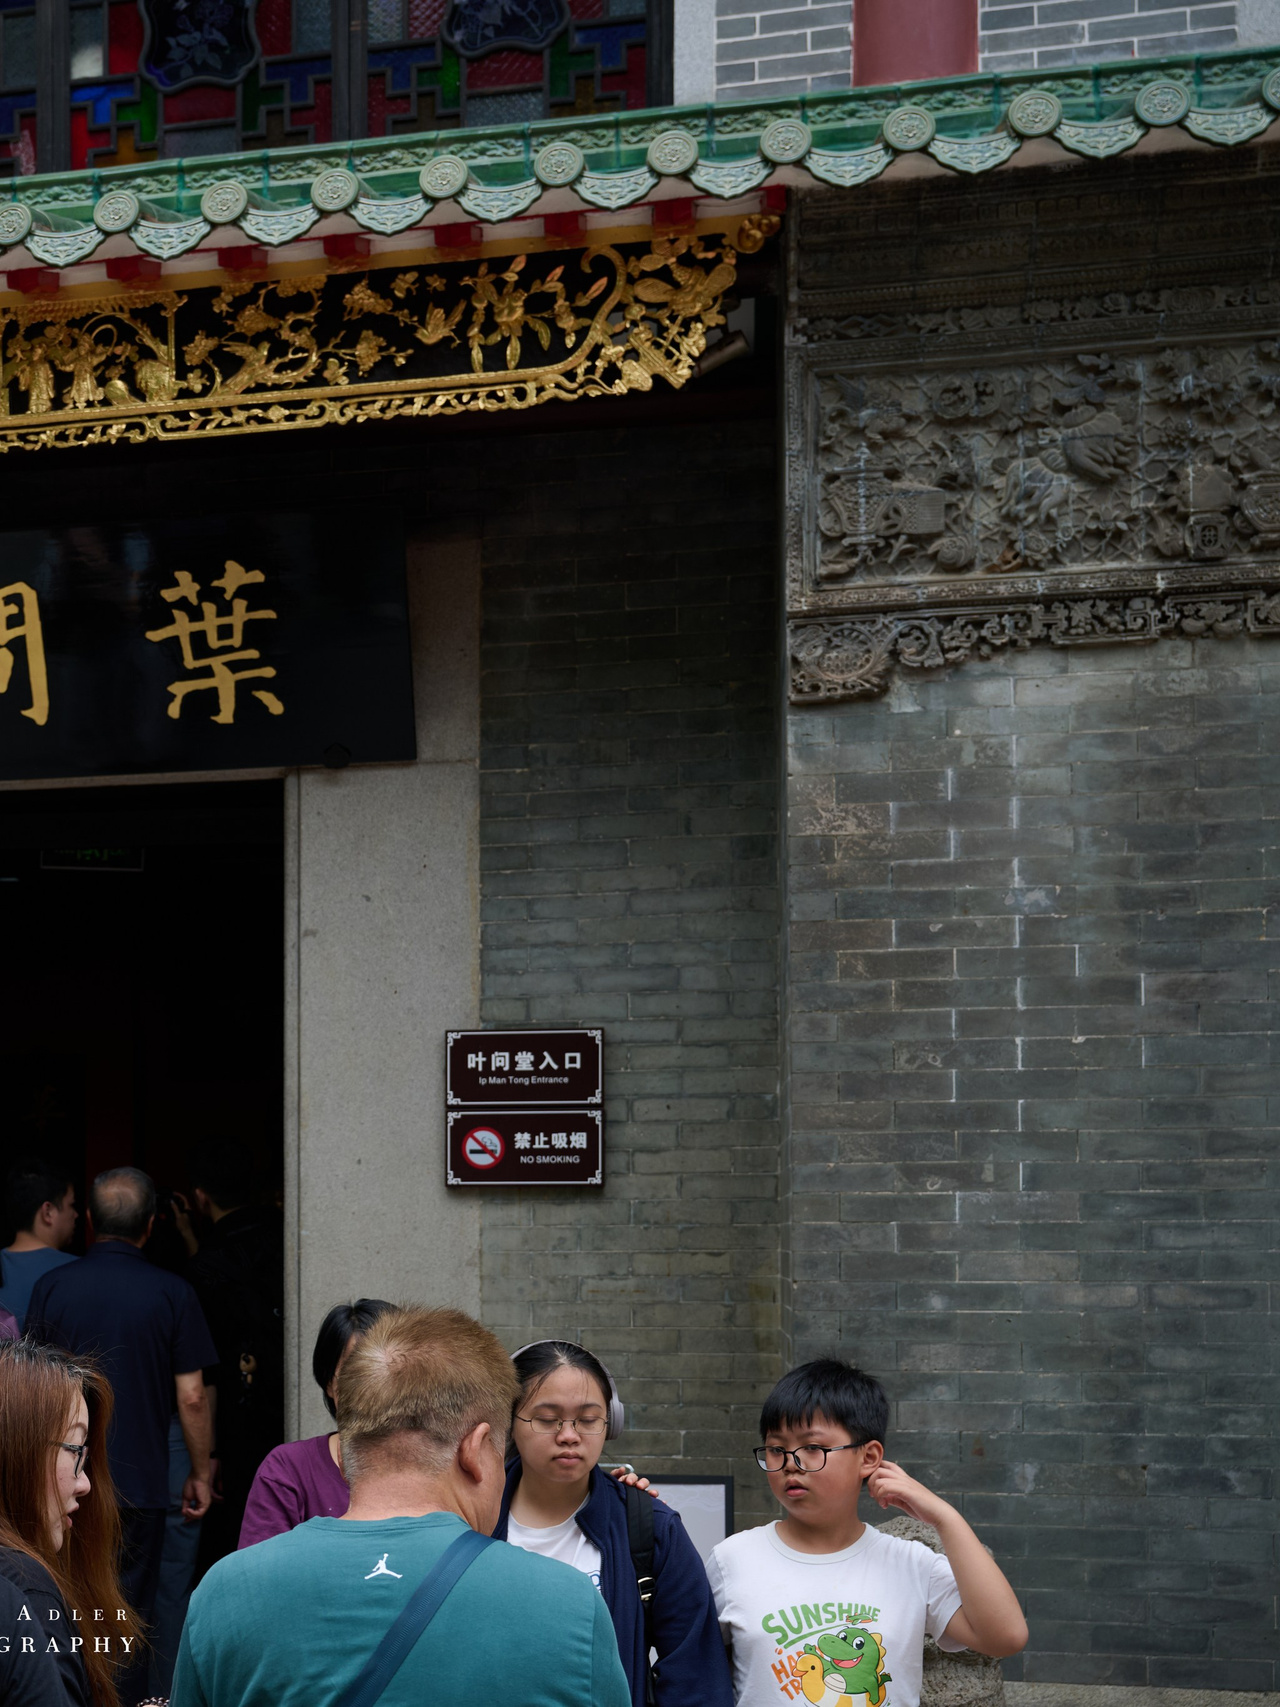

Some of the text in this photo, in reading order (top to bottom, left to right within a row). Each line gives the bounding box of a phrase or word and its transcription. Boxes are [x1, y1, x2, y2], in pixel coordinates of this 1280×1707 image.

[467, 1051, 582, 1072] 叶问堂入口
[478, 1076, 569, 1086] Ip Man Tong Entrance
[513, 1132, 587, 1149] 禁止吸烟
[520, 1155, 580, 1164] NO SMOKING
[761, 1602, 881, 1646] SUNSHINE
